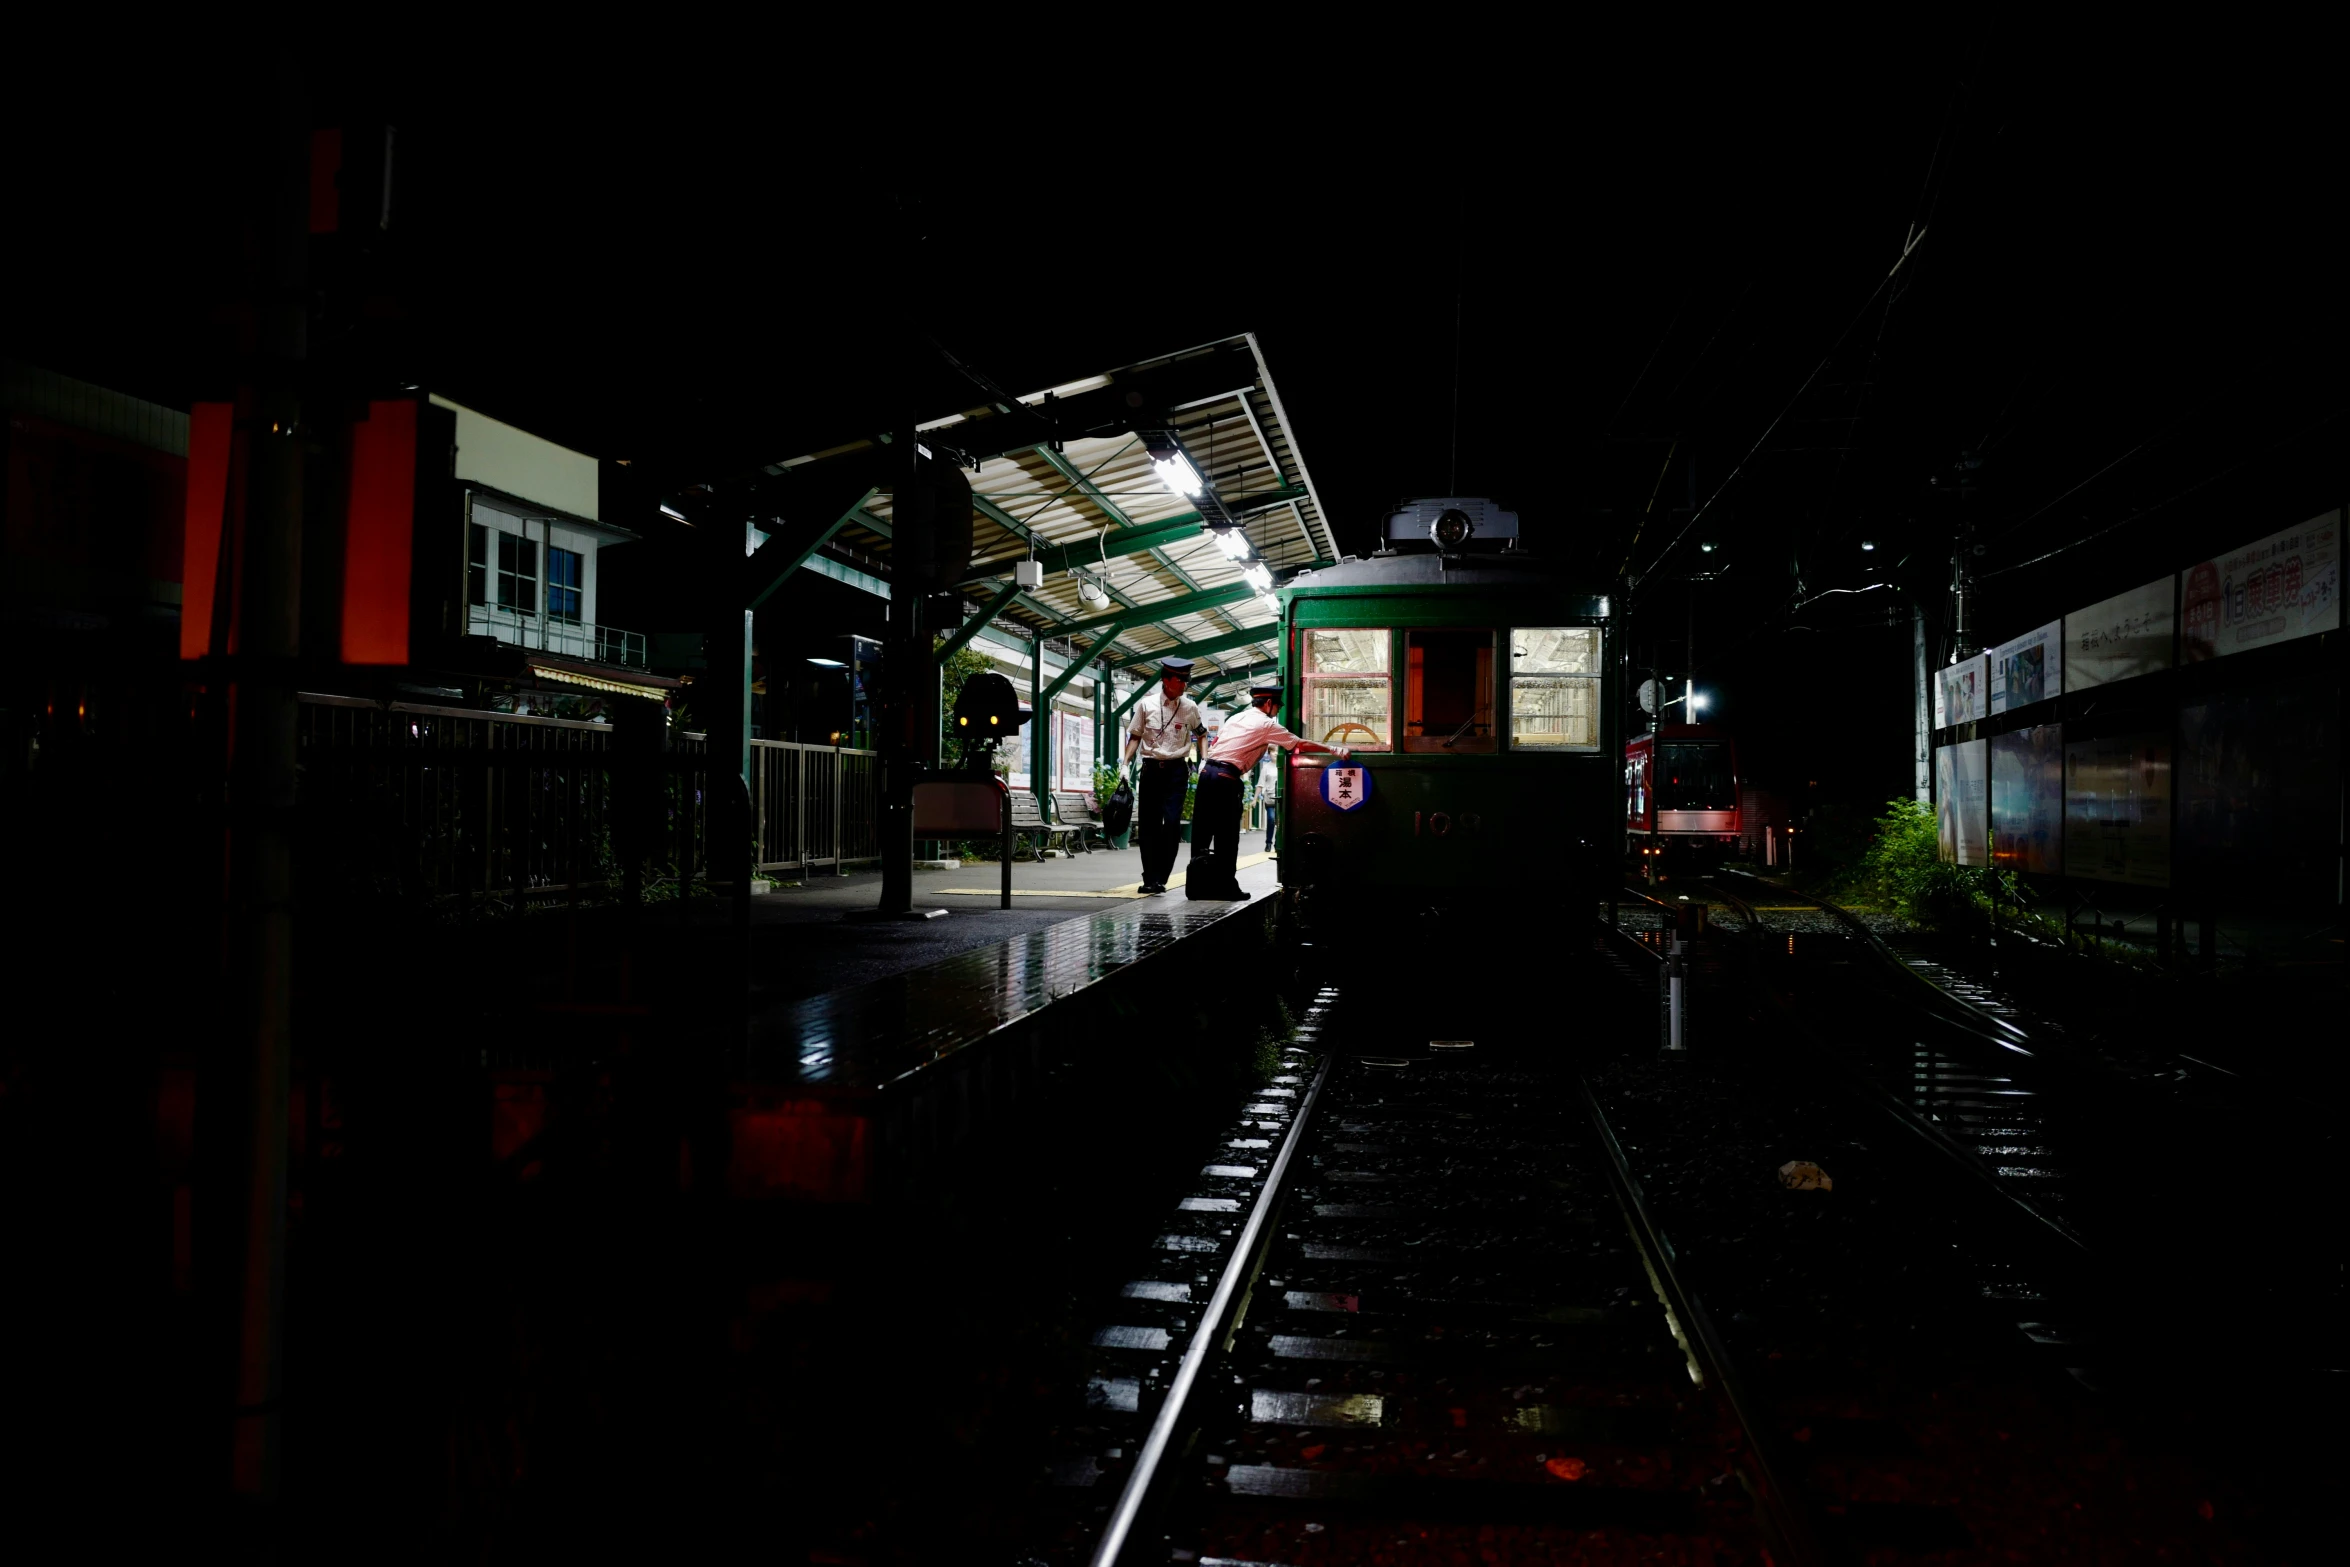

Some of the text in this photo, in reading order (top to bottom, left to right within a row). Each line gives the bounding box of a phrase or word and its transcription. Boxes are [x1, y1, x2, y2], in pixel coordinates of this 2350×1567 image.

[2223, 556, 2304, 627] 1日乗車券
[1335, 769, 1356, 777] 箱根
[1339, 777, 1352, 799] 湯本
[1414, 810, 1481, 837] 109
